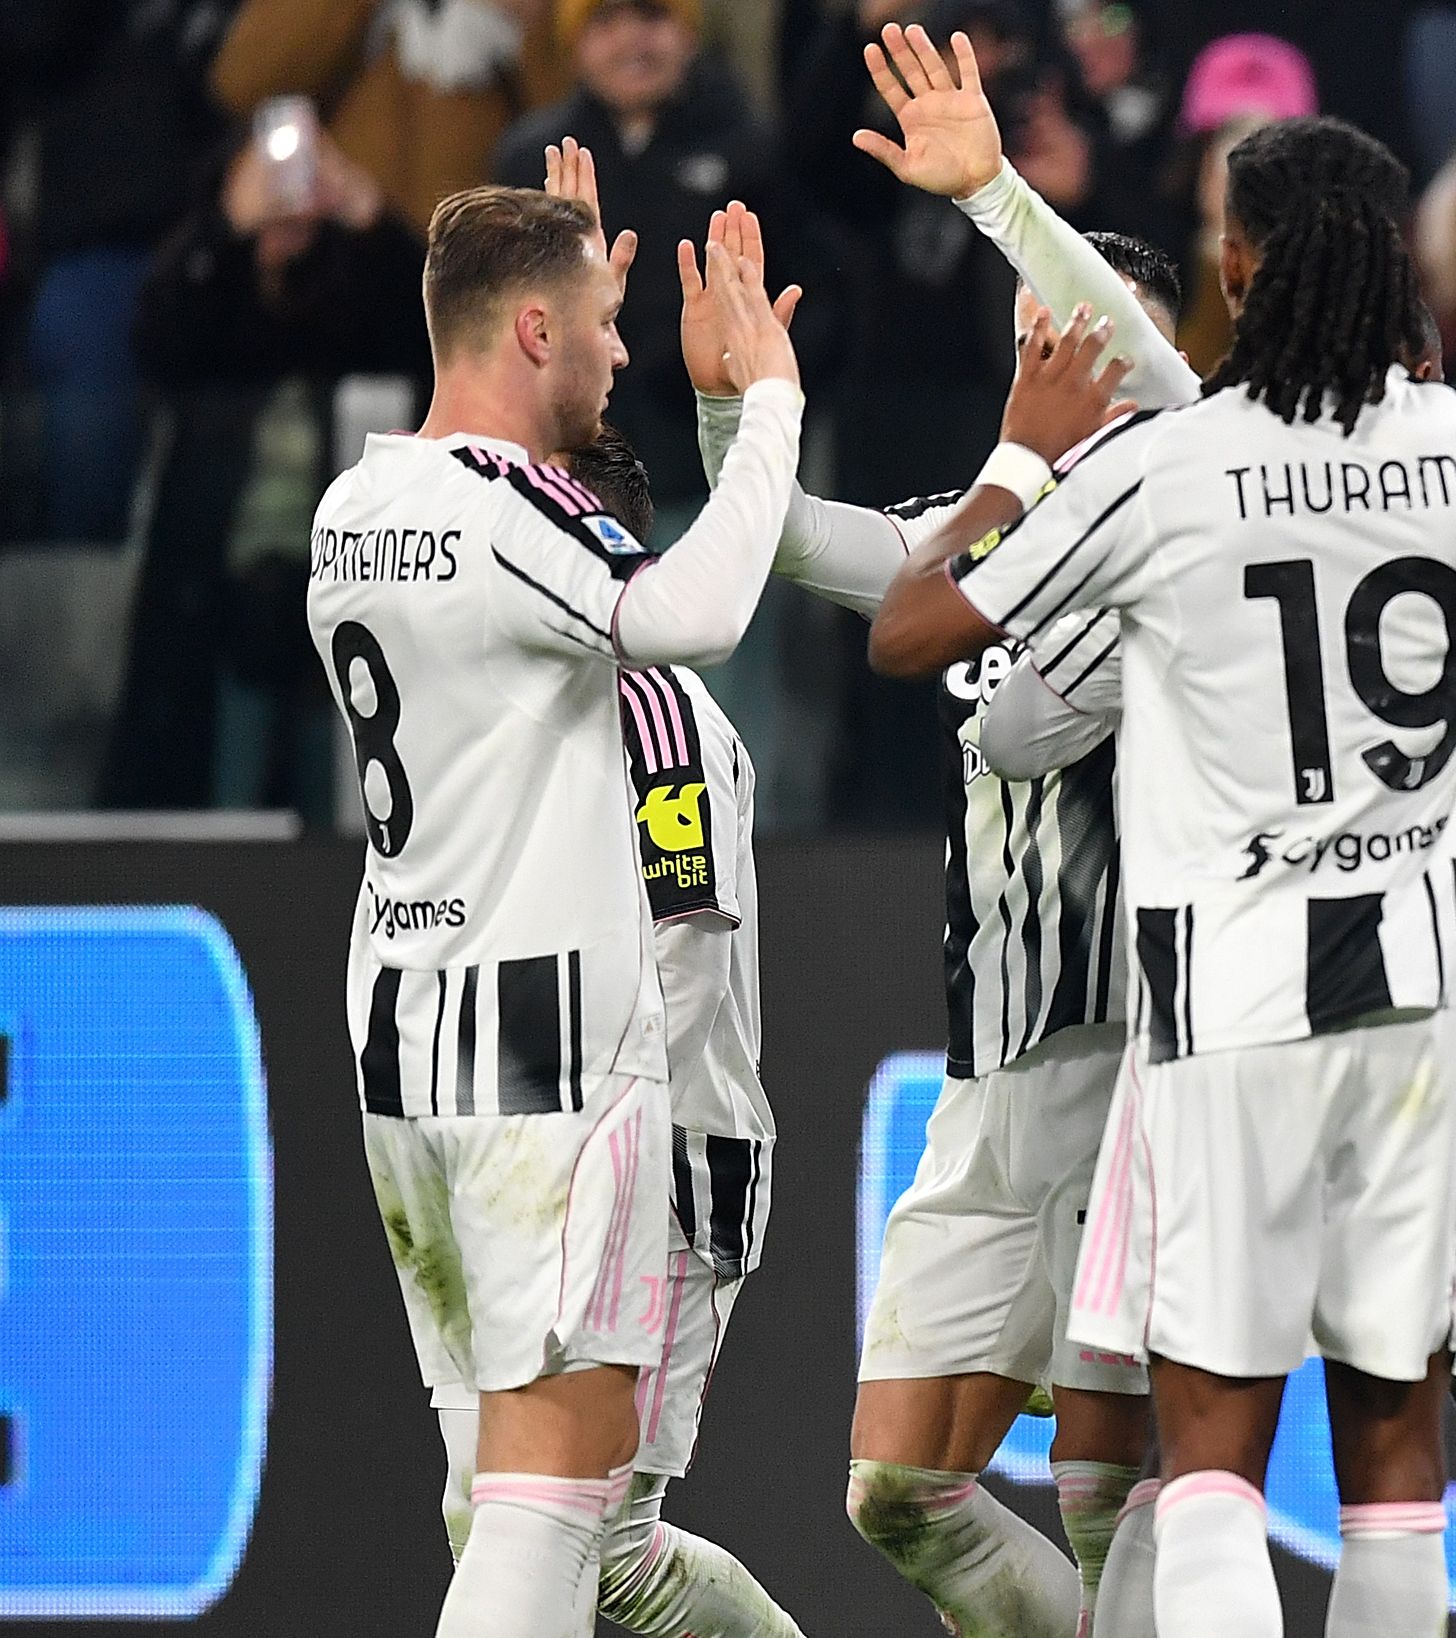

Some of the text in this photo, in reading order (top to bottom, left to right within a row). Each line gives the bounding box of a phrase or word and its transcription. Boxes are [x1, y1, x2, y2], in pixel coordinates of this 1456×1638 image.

[332, 620, 414, 859] 8
[642, 854, 706, 880] white
[677, 868, 709, 888] bit
